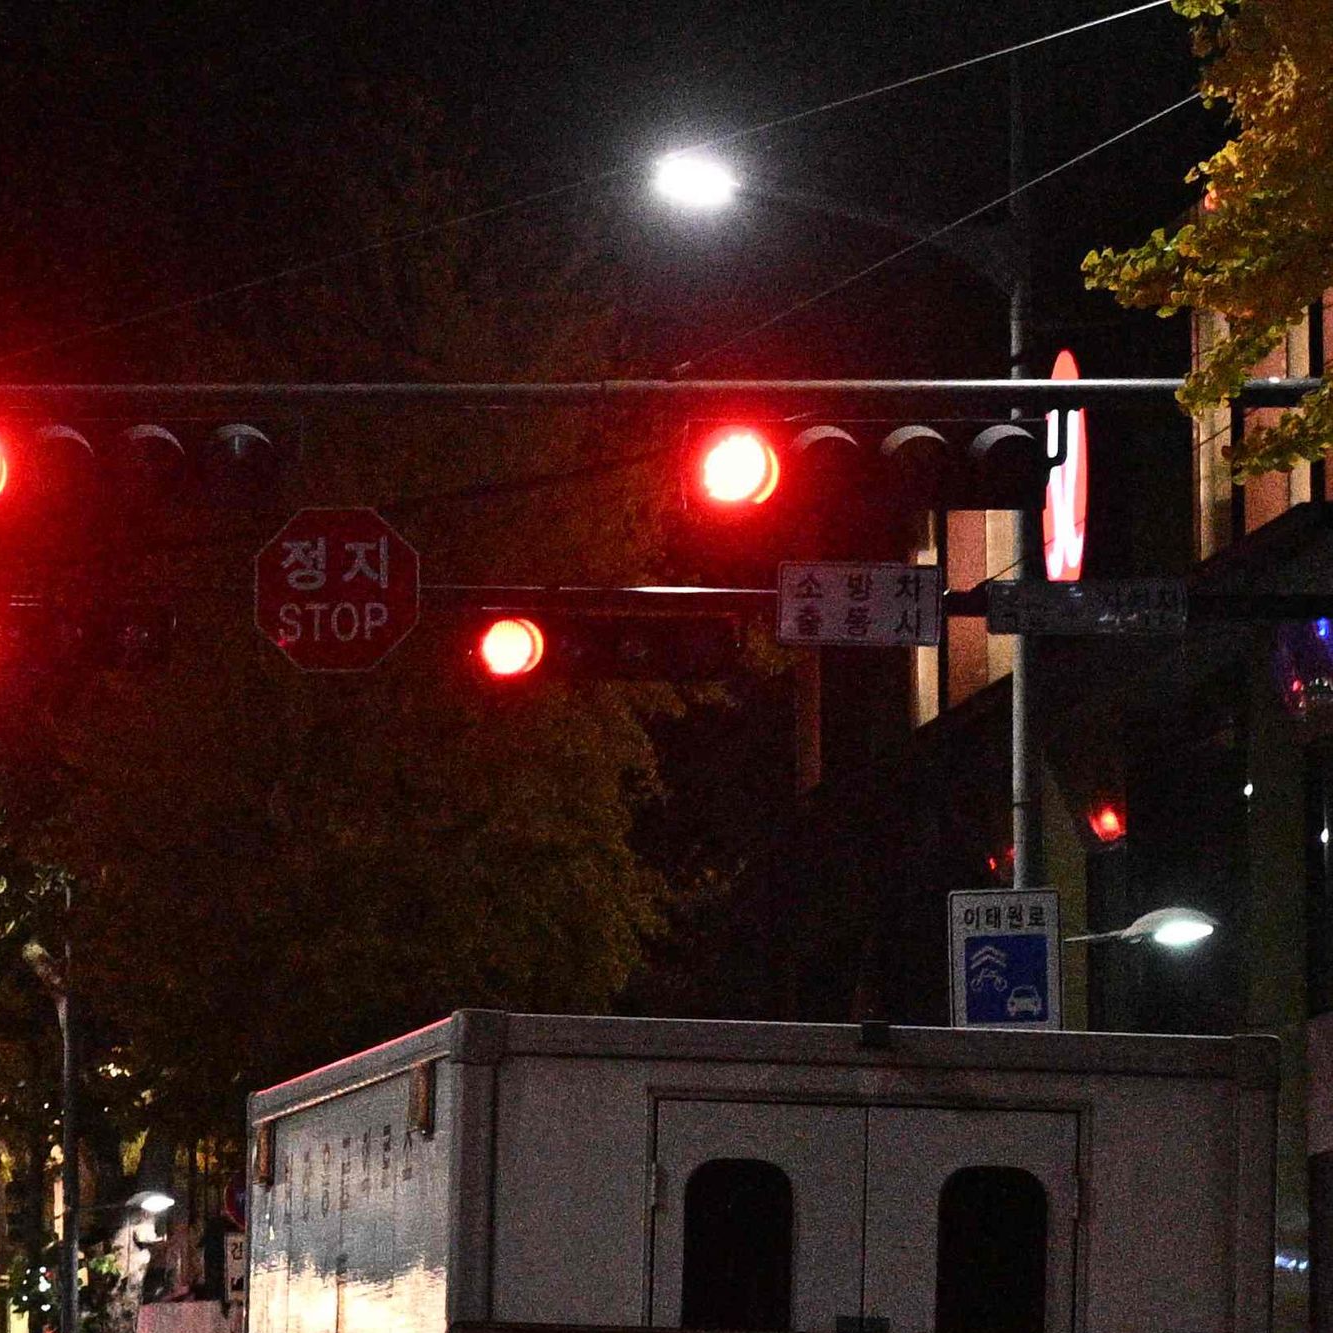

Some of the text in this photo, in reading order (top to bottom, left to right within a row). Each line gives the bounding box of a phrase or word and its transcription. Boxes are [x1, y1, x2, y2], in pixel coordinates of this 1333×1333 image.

[280, 536, 389, 590] 정지
[794, 571, 924, 602] 소방차
[278, 601, 389, 642] STOP
[964, 903, 1046, 930] 이태원로
